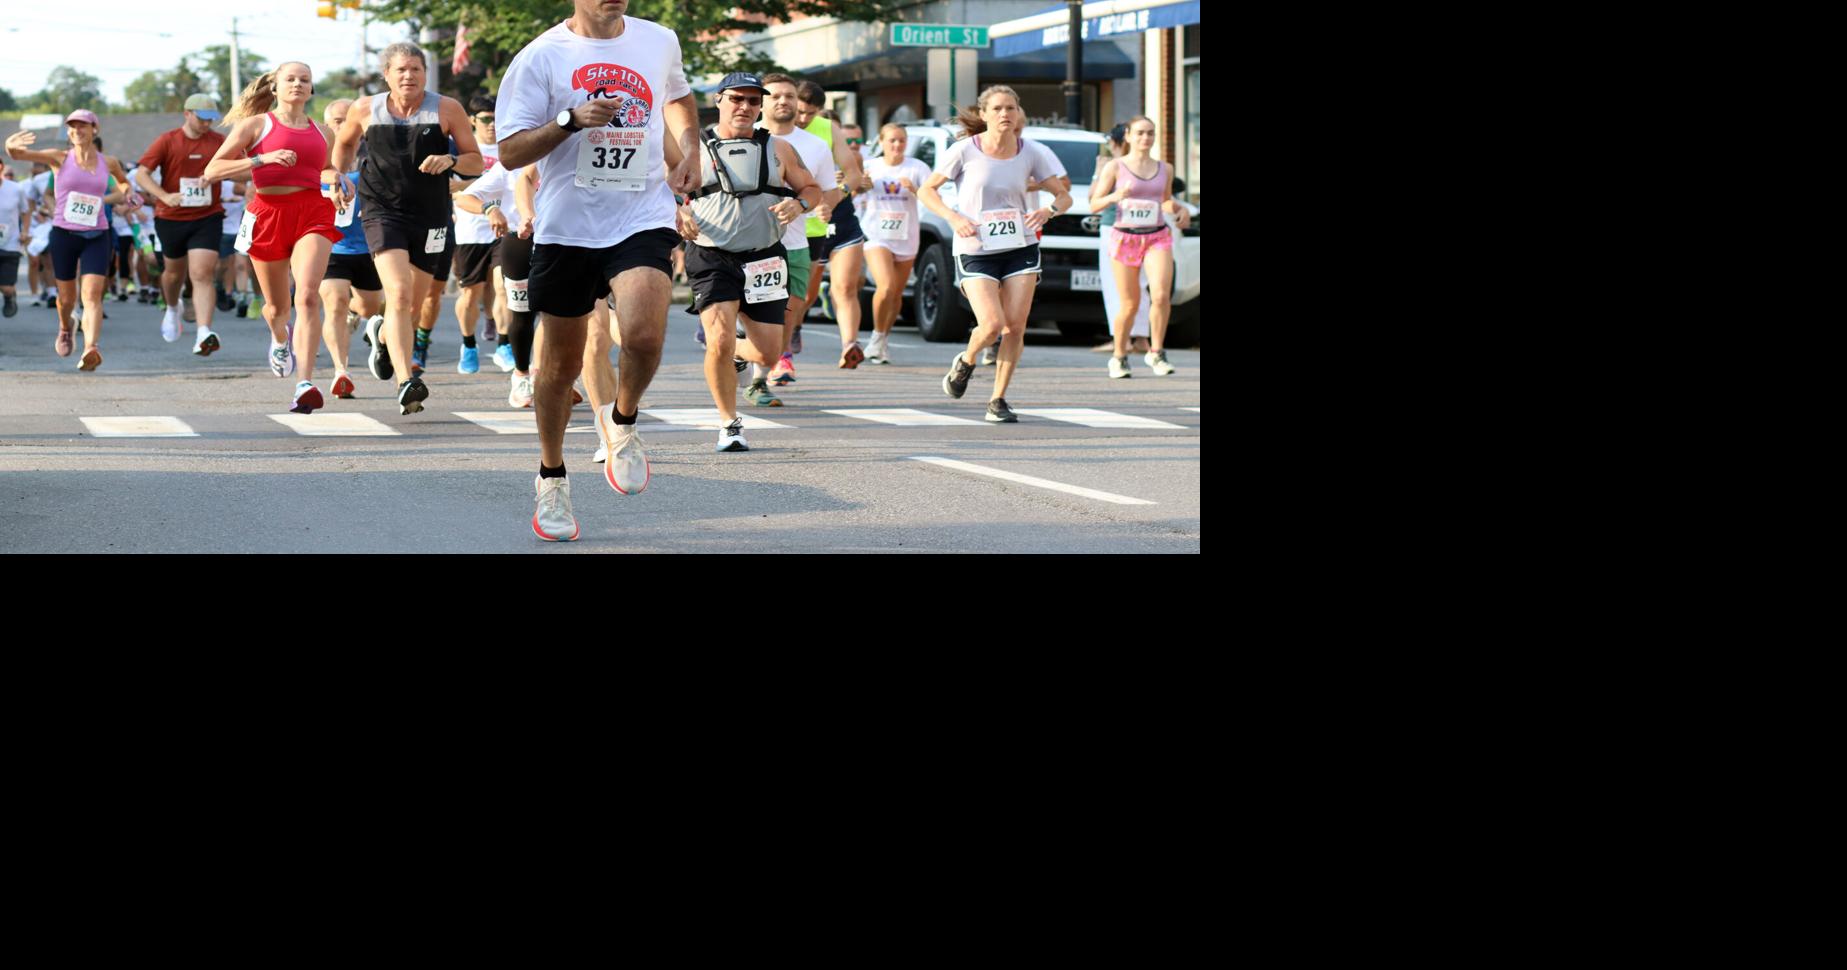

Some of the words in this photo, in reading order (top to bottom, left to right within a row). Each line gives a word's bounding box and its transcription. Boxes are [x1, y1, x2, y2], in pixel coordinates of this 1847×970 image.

[902, 27, 950, 43] Orient
[963, 29, 979, 44] St
[620, 81, 637, 94] race
[606, 131, 622, 139] MAINE
[592, 147, 637, 169] 337
[187, 187, 205, 197] 341
[72, 202, 94, 216] 258
[881, 219, 903, 230] 227
[988, 220, 1017, 236] 229
[753, 270, 782, 288] 329
